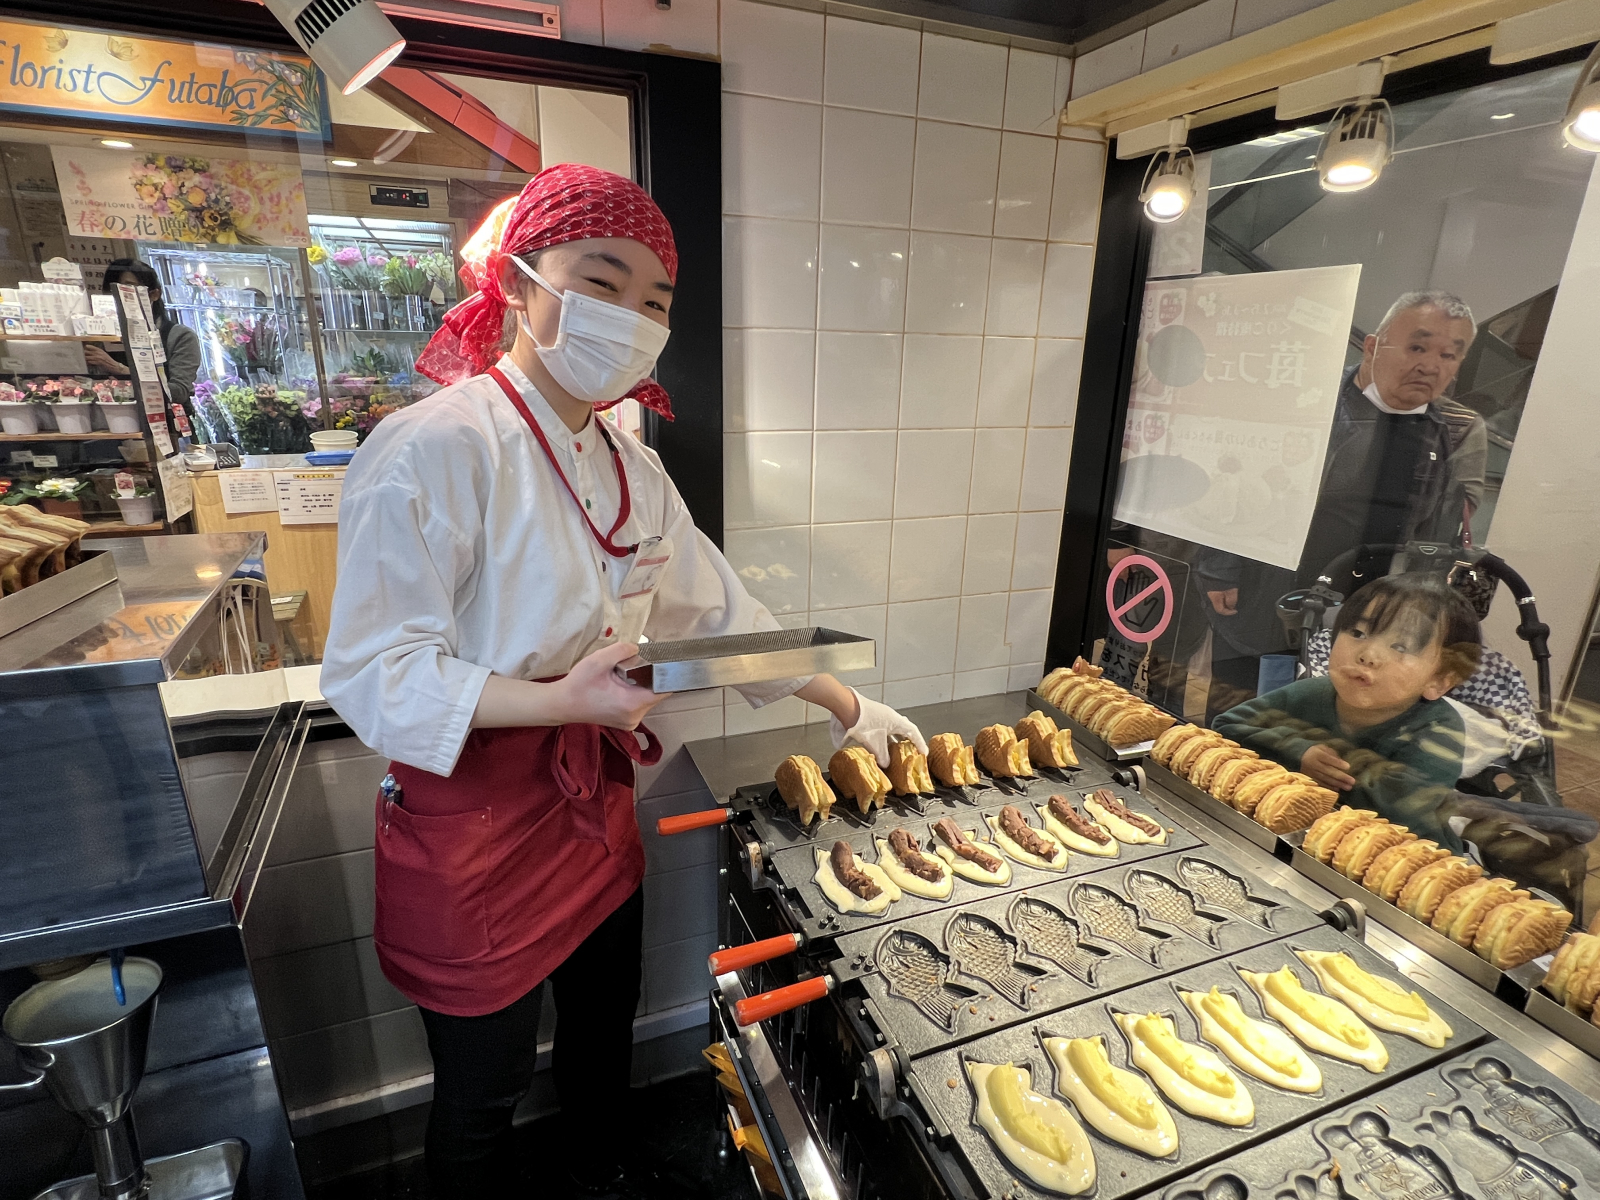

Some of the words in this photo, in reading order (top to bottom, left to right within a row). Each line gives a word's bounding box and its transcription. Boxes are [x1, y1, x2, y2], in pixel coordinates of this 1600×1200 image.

[75, 208, 201, 239] 春の花贈り
